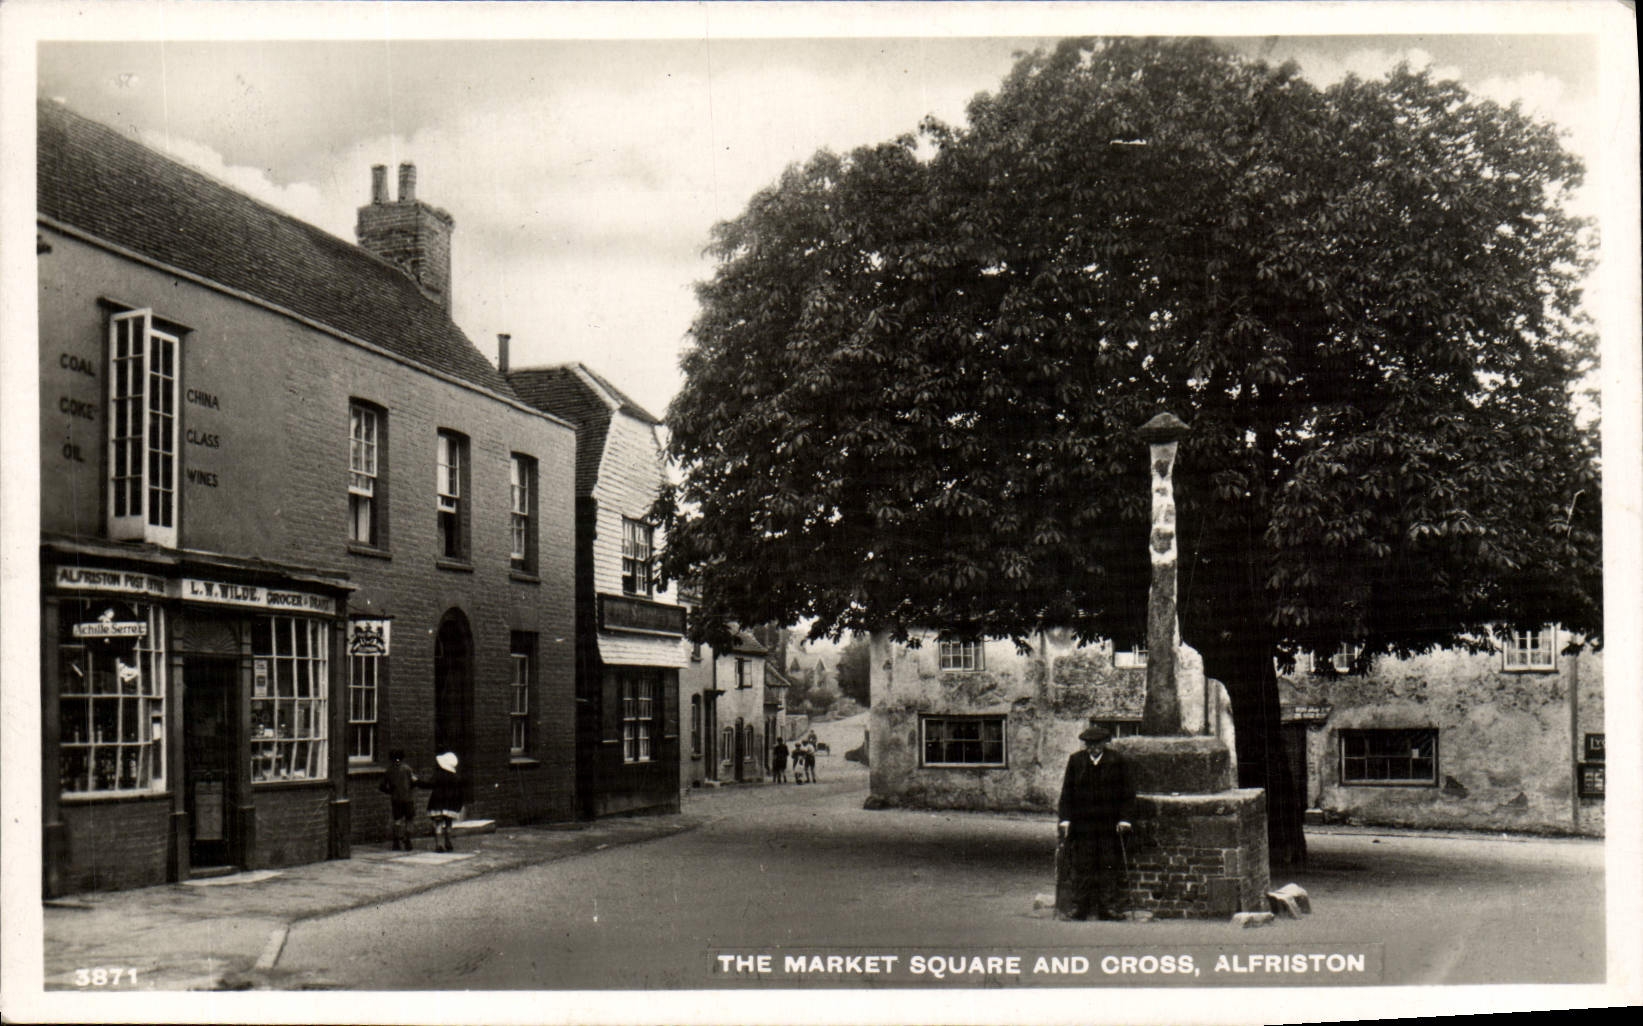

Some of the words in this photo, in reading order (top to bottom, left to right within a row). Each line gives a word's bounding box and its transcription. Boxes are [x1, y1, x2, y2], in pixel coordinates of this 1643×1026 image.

[59, 353, 97, 377] COAL
[59, 396, 96, 421] COKE
[186, 389, 221, 411] CHINA
[62, 443, 86, 463] OIL
[187, 468, 219, 488] WINES
[59, 567, 121, 587] ALFRISTON
